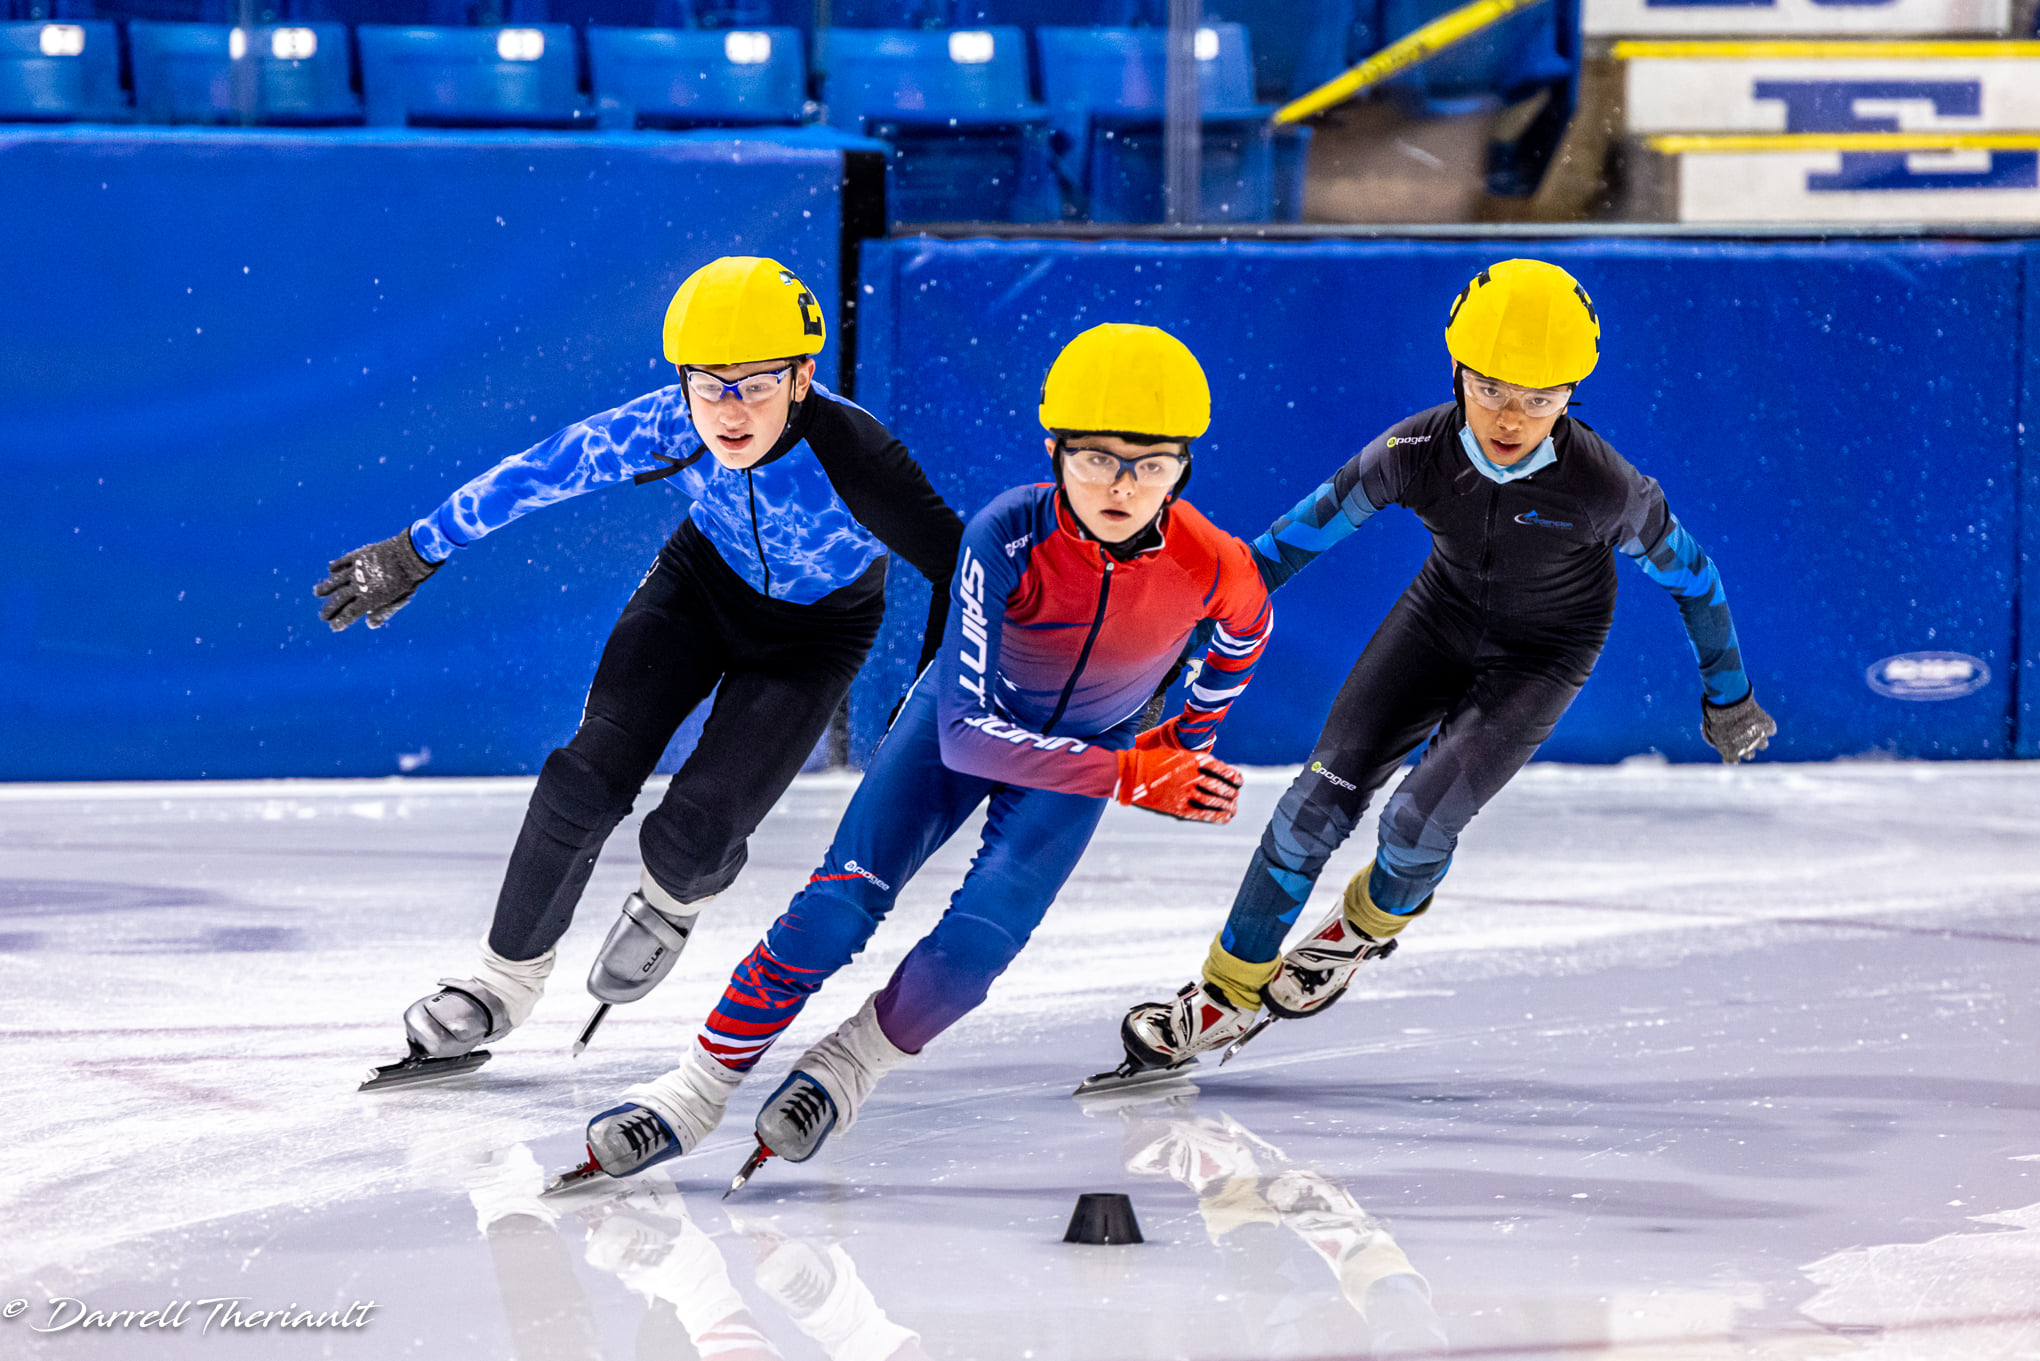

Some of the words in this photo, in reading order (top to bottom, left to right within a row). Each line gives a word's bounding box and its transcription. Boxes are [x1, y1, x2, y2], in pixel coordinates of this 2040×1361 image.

[959, 545, 988, 708] SAINT
[1311, 761, 1357, 791] apogee
[843, 859, 890, 891] apogee
